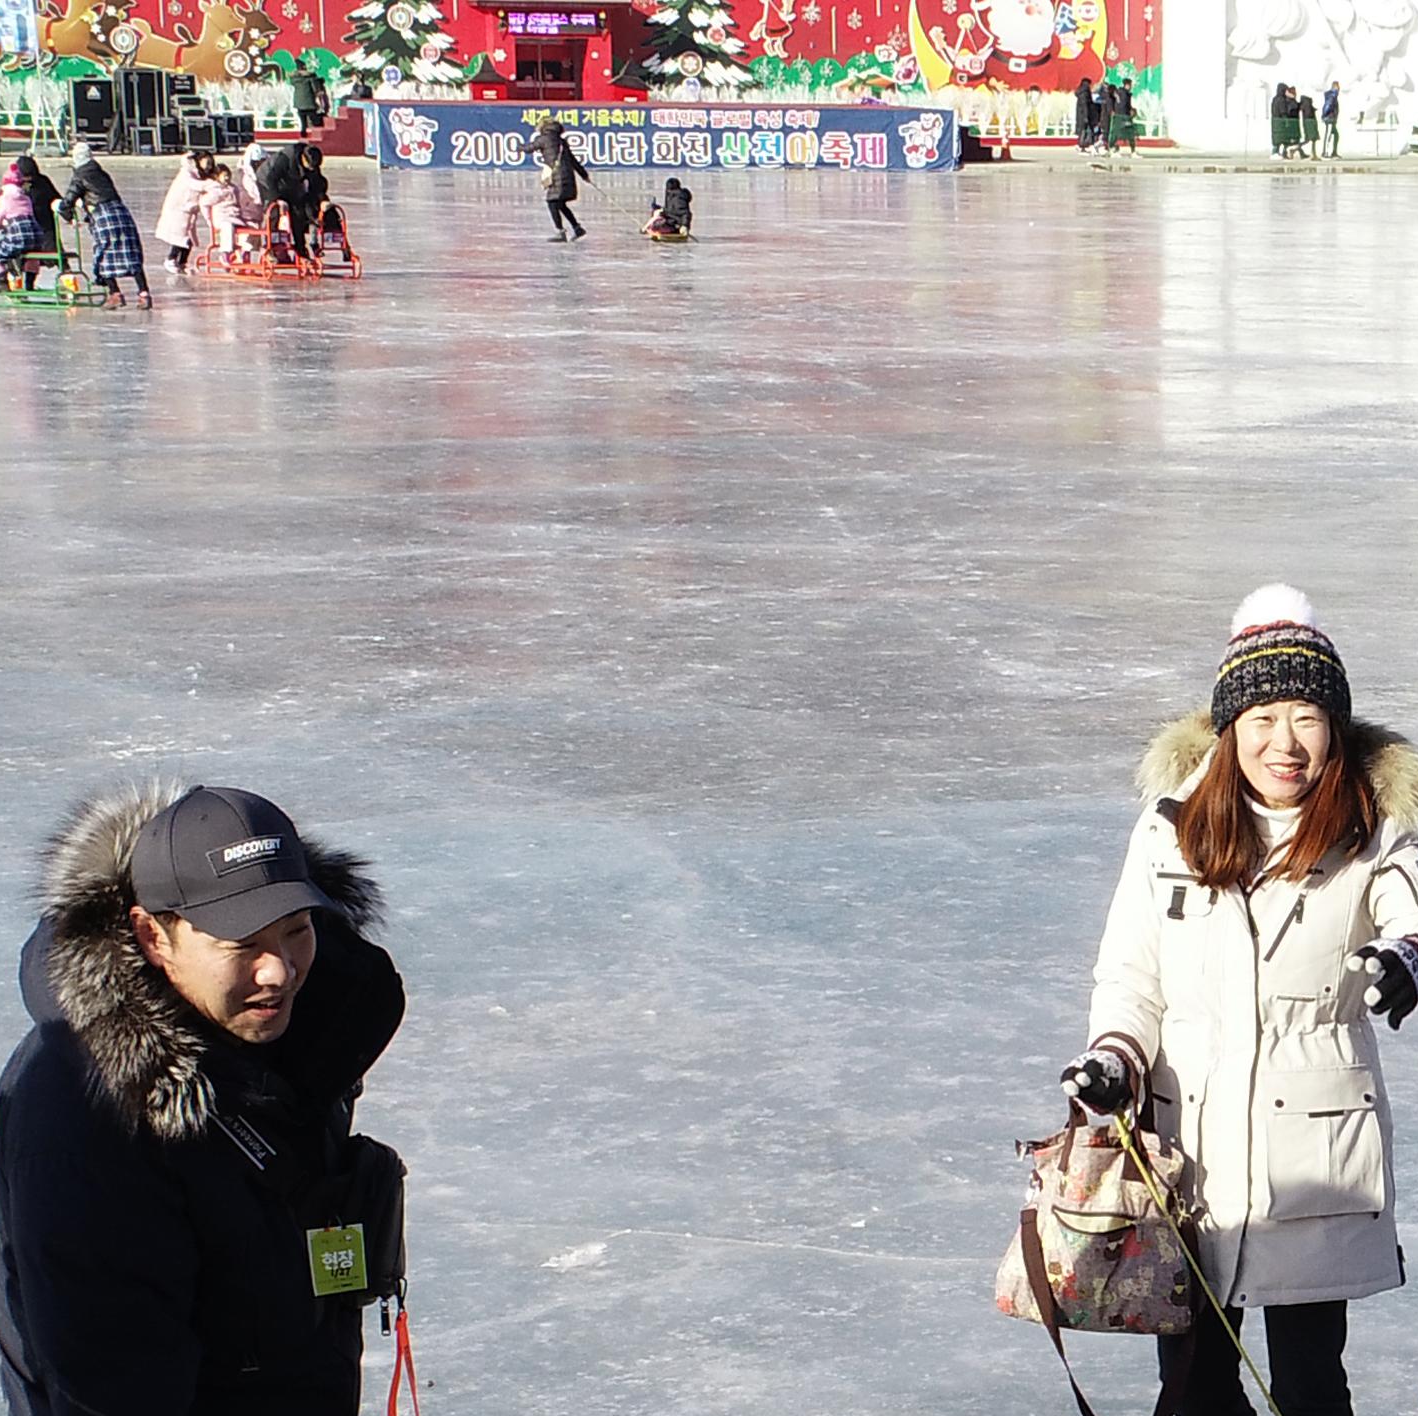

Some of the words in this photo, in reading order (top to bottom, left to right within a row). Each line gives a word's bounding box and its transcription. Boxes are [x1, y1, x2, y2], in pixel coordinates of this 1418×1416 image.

[651, 109, 708, 128] 대한민국
[710, 110, 753, 129] 글로벌
[451, 131, 525, 166] 2019
[652, 131, 712, 168] 화천
[223, 838, 281, 862] DISCOVERY
